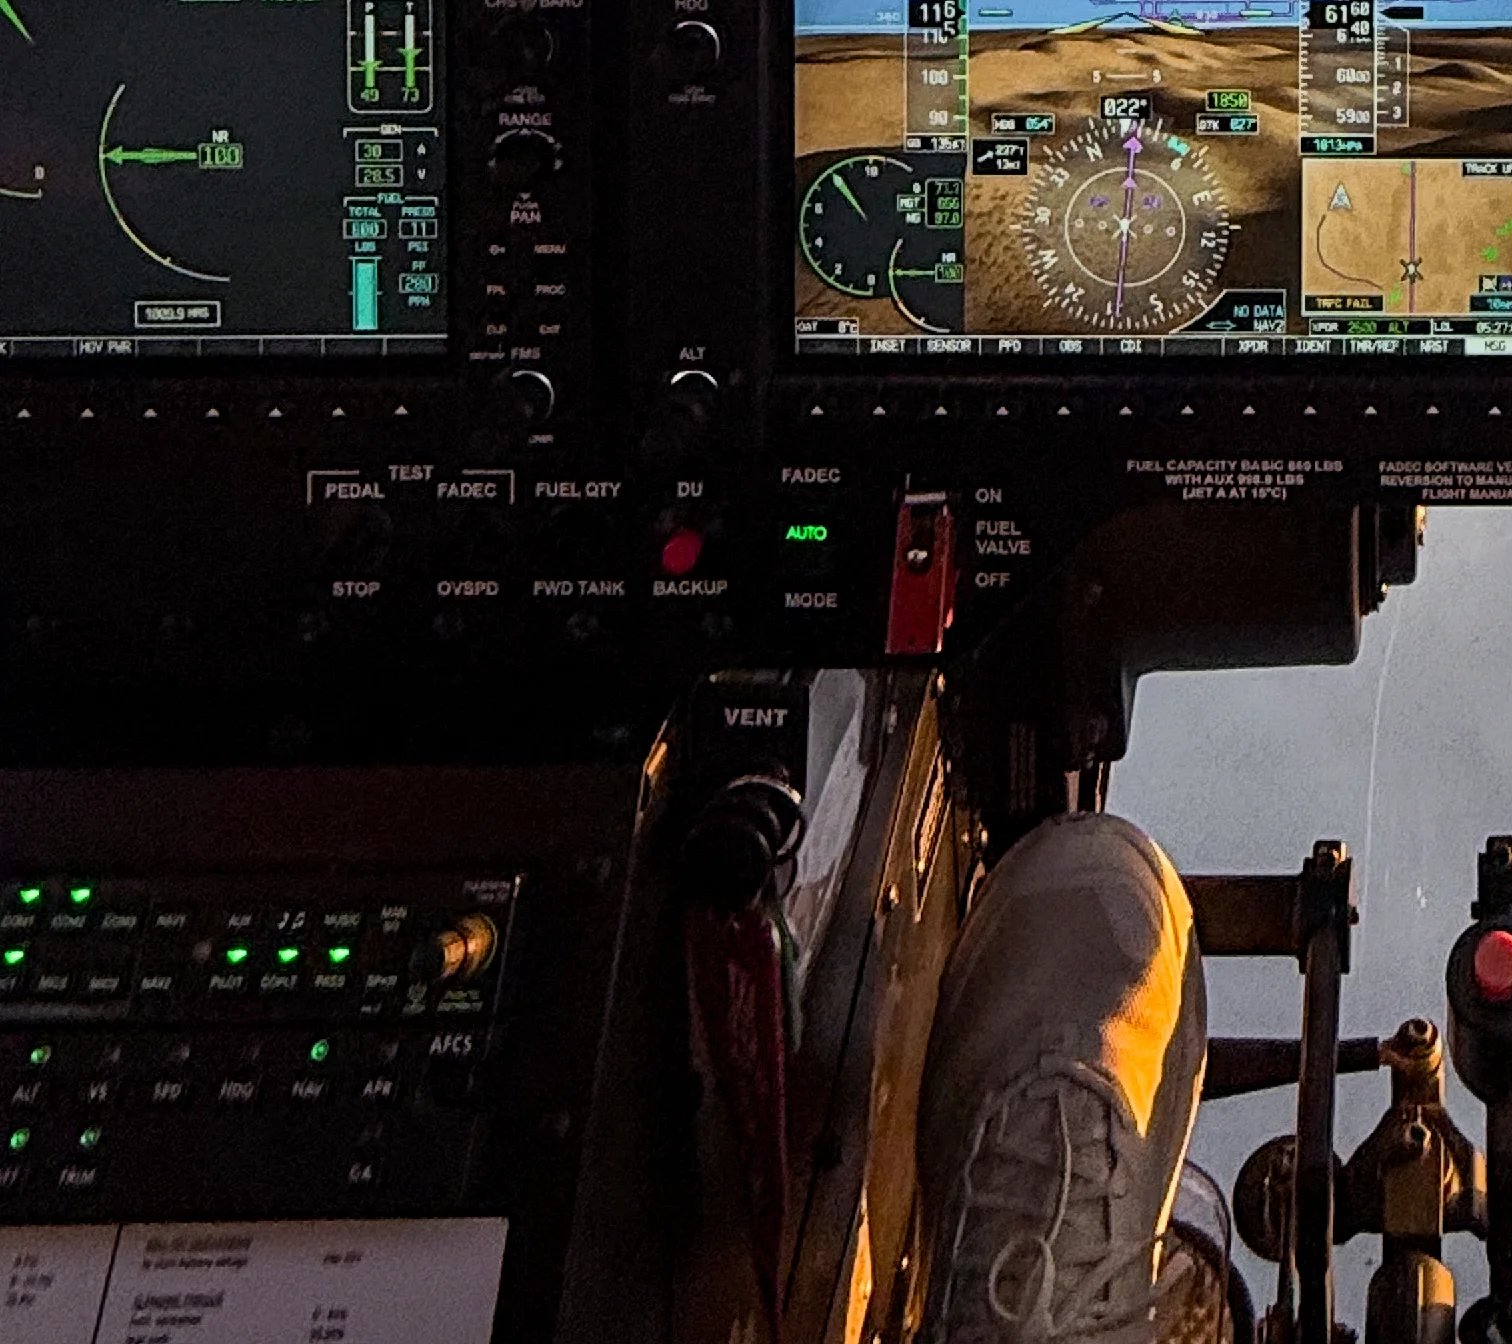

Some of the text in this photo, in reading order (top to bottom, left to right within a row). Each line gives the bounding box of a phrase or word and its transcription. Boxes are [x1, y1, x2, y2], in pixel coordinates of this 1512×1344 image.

[921, 69, 948, 86] 100
[1336, 68, 1371, 83] 6000
[1393, 81, 1401, 95] 2
[1104, 98, 1147, 117] 022°
[1393, 106, 1401, 119] 3
[498, 112, 553, 126] RANGE
[929, 110, 948, 126] 90
[1336, 108, 1370, 123] 5900
[212, 129, 229, 143] NR
[203, 146, 240, 166] 100
[1086, 144, 1103, 162] N
[363, 169, 395, 183] 28.5
[865, 166, 879, 177] 10
[1051, 168, 1070, 188] 33
[1192, 192, 1212, 206] E
[510, 211, 542, 223] PAN
[815, 237, 823, 248] 4
[1201, 231, 1216, 248] 12
[1038, 250, 1058, 269] W
[834, 263, 843, 275] 2
[1182, 270, 1200, 288] 15
[1150, 293, 1164, 312] S
[1347, 298, 1372, 309] FAIL
[1233, 305, 1284, 318] NO DATA
[1254, 320, 1285, 332] NAV2
[870, 340, 906, 352] INSET
[927, 340, 971, 352] SENSOR
[999, 341, 1022, 352] PFD
[1120, 340, 1142, 352] CDI
[1237, 340, 1269, 353] XPDR
[1295, 340, 1332, 353] IDENT
[1420, 340, 1449, 353] NRST
[1484, 340, 1506, 353] MSG
[679, 347, 705, 361] ALT
[388, 465, 435, 481] TEST
[1127, 460, 1284, 471] FUEL CAPACITY BASIC
[1379, 461, 1421, 473] FADEC
[1424, 461, 1493, 473] SOFTWARE
[781, 468, 842, 483] FADEC
[1165, 474, 1234, 486] WITH AUX
[1380, 474, 1453, 486] REVERSION
[1456, 475, 1474, 486] TO
[325, 482, 385, 499] PEDAL
[437, 482, 497, 498] FADEC
[535, 482, 622, 499] FUEL QTY
[676, 481, 704, 498] DU
[975, 489, 1001, 504] ON
[1182, 487, 1247, 500] (JET A AT
[1421, 488, 1466, 500] FLIGHT
[785, 525, 828, 541] AUTO
[976, 521, 1021, 536] FUEL
[976, 540, 1031, 556] VALVE
[975, 572, 1011, 588] OFF
[332, 581, 381, 597] STOP
[437, 581, 499, 597] OVSPD
[533, 581, 626, 597] FWD TANK
[652, 580, 728, 596] BACKUP
[785, 593, 838, 608] MODE
[724, 708, 790, 727] VENT
[429, 1034, 473, 1055] AFCS
